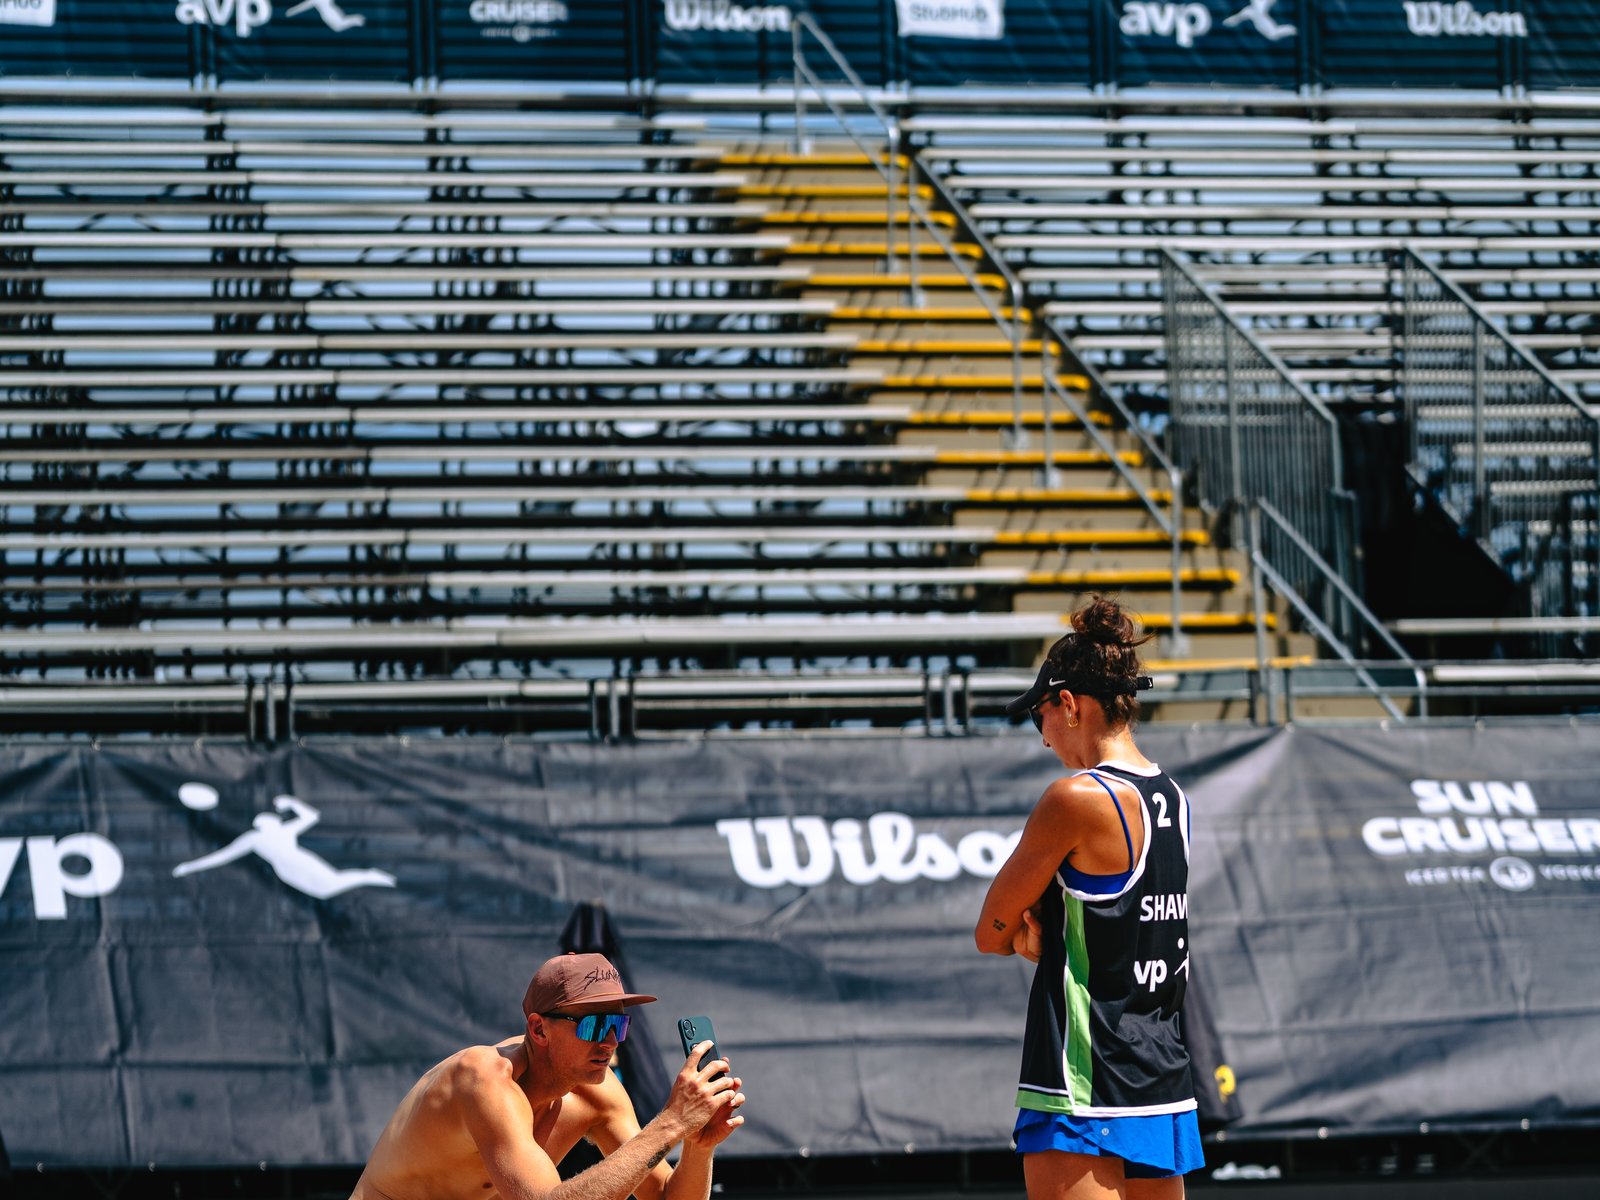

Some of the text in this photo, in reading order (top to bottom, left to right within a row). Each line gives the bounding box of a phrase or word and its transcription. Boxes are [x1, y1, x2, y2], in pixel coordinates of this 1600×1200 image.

[175, 0, 272, 37] avp
[663, 0, 791, 31] Wilson
[909, 4, 988, 21] StubHub
[1119, 1, 1212, 47] avp
[1403, 1, 1528, 37] Wilson
[1151, 792, 1172, 828] 2
[1410, 779, 1539, 816] SUN
[716, 812, 1023, 888] Wilso
[1361, 816, 1600, 855] CRUISER
